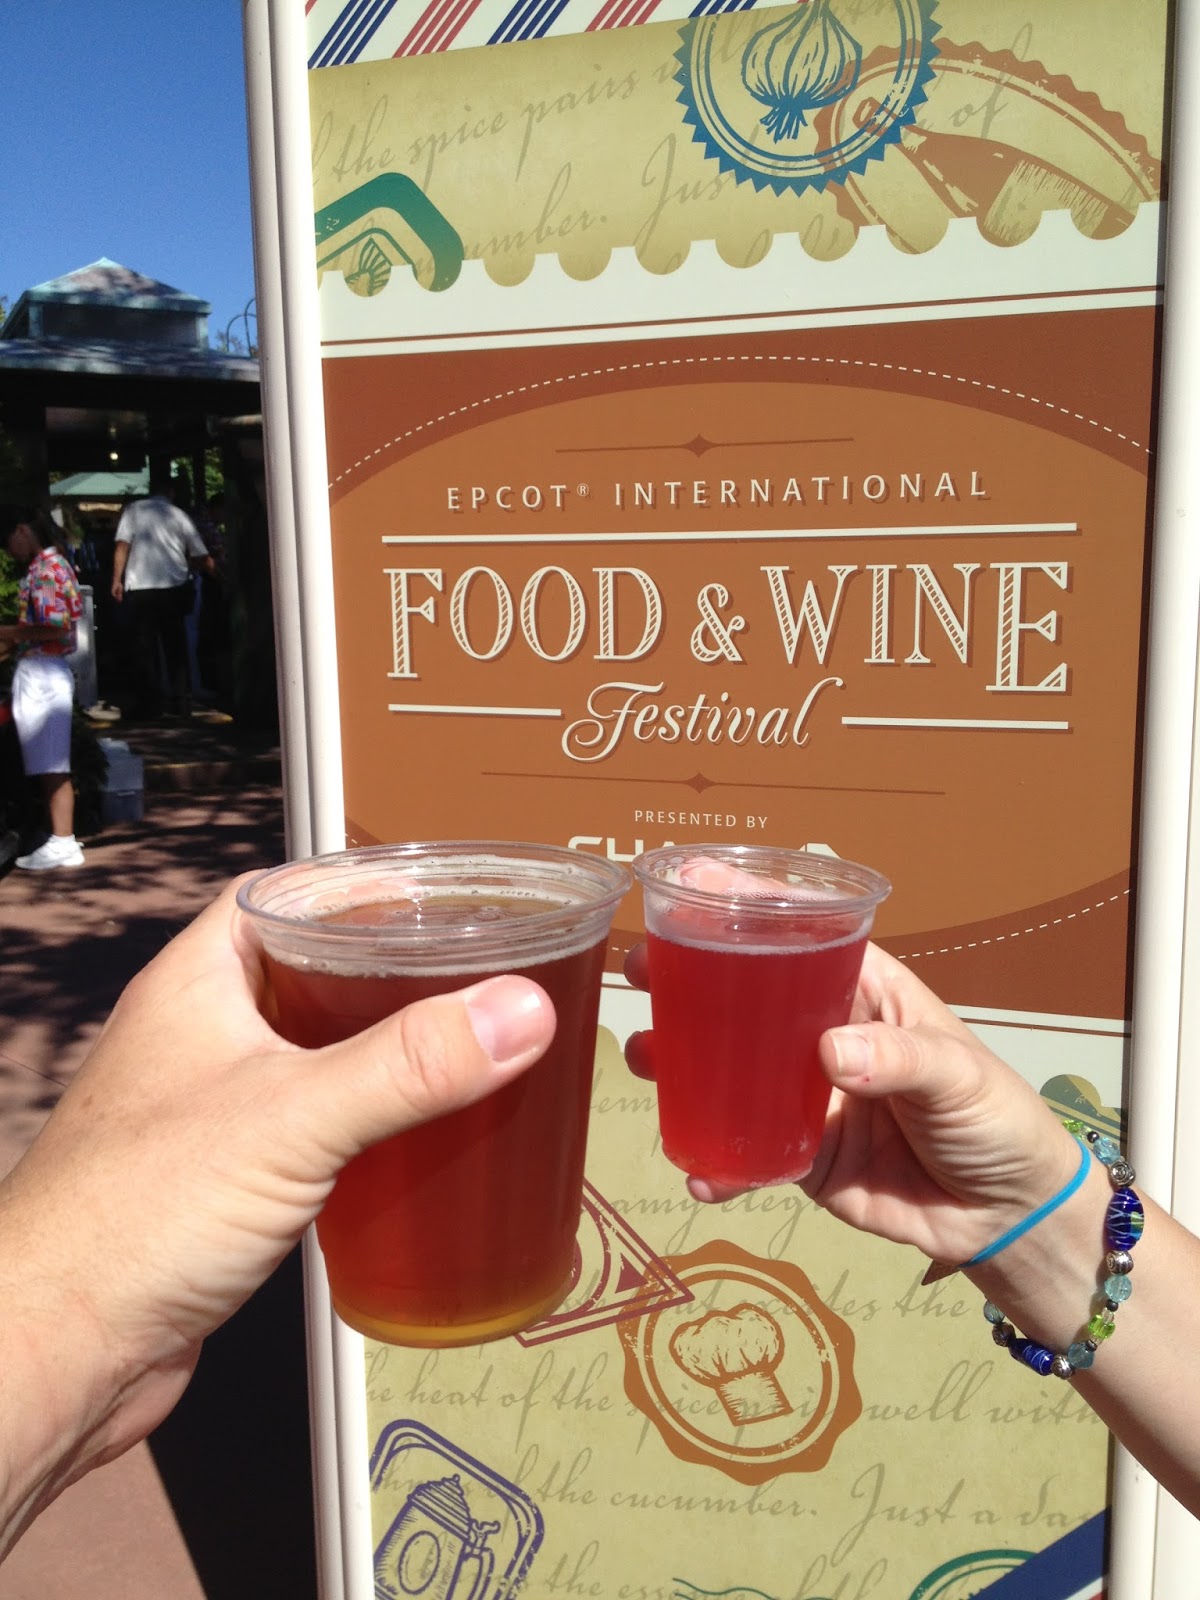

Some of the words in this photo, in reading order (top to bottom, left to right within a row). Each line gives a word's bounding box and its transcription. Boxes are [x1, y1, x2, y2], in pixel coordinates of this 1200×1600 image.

[331, 94, 396, 183] the
[407, 104, 509, 194] spice
[519, 63, 641, 183] pairs
[614, 470, 988, 507] INTERNATIONAL
[382, 566, 664, 679] FOOD
[690, 582, 747, 664] &
[760, 561, 1070, 693] WINE
[560, 676, 845, 762] Festival
[634, 809, 738, 828] PRESENTED
[746, 815, 769, 829] BY
[364, 1346, 395, 1403] he
[404, 1348, 494, 1408] heat
[499, 1349, 556, 1455] of
[552, 1351, 616, 1412] the
[863, 1359, 995, 1422] well
[536, 1446, 600, 1505] the
[610, 1475, 818, 1517] cucumber.
[831, 1462, 965, 1568] Just
[969, 1509, 1002, 1526] a
[544, 1539, 607, 1597] the
